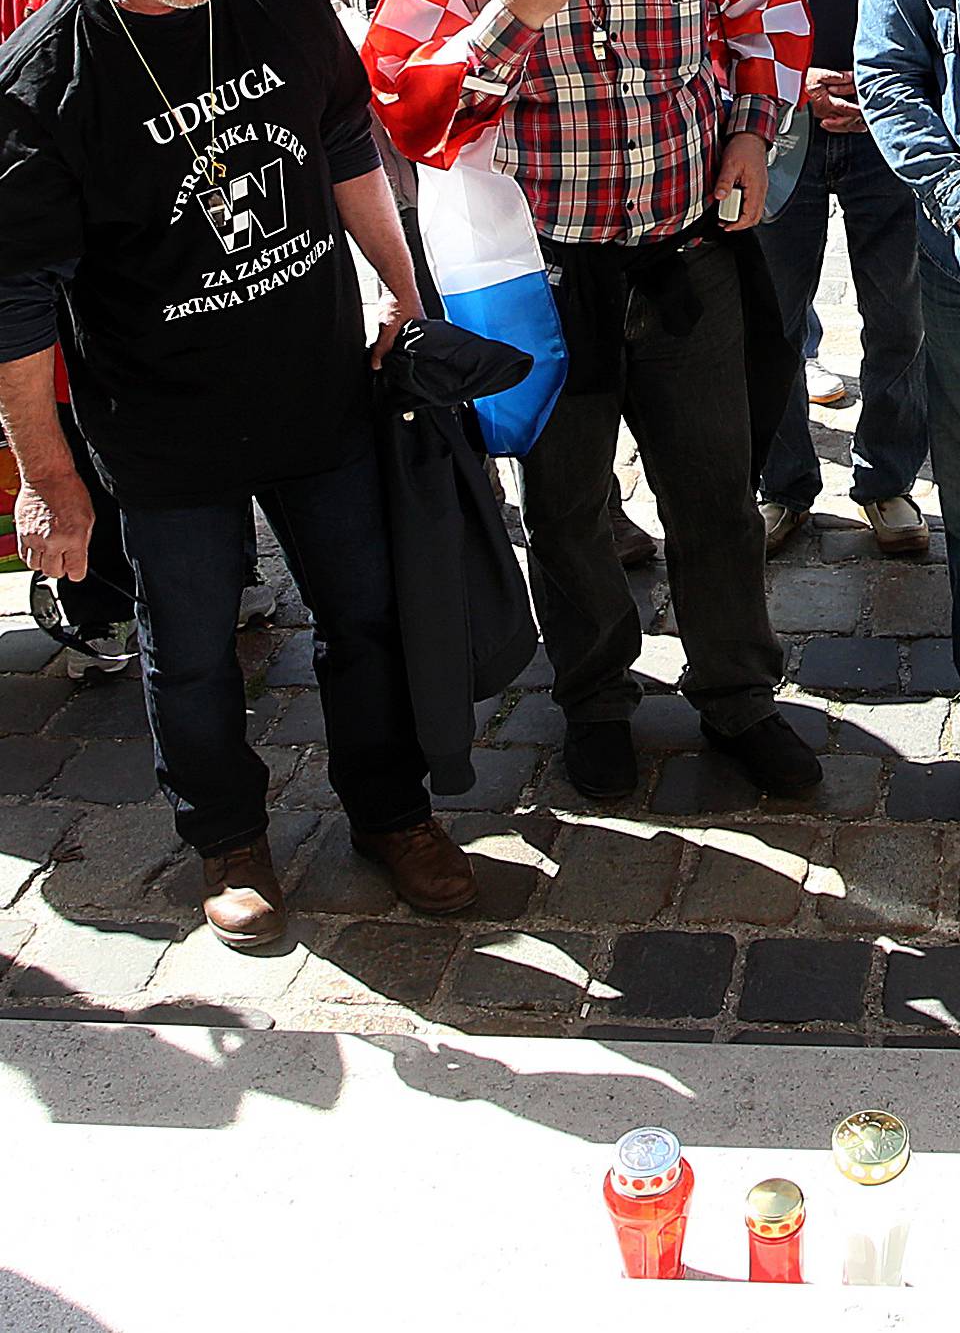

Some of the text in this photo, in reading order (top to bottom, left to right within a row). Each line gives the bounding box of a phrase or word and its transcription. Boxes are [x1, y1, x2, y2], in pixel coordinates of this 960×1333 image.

[142, 63, 287, 145] UDRUGA
[170, 123, 259, 225] VERONIKA
[202, 229, 311, 288] ZA ZAŠTITU
[163, 290, 244, 322] ŽRTAVA
